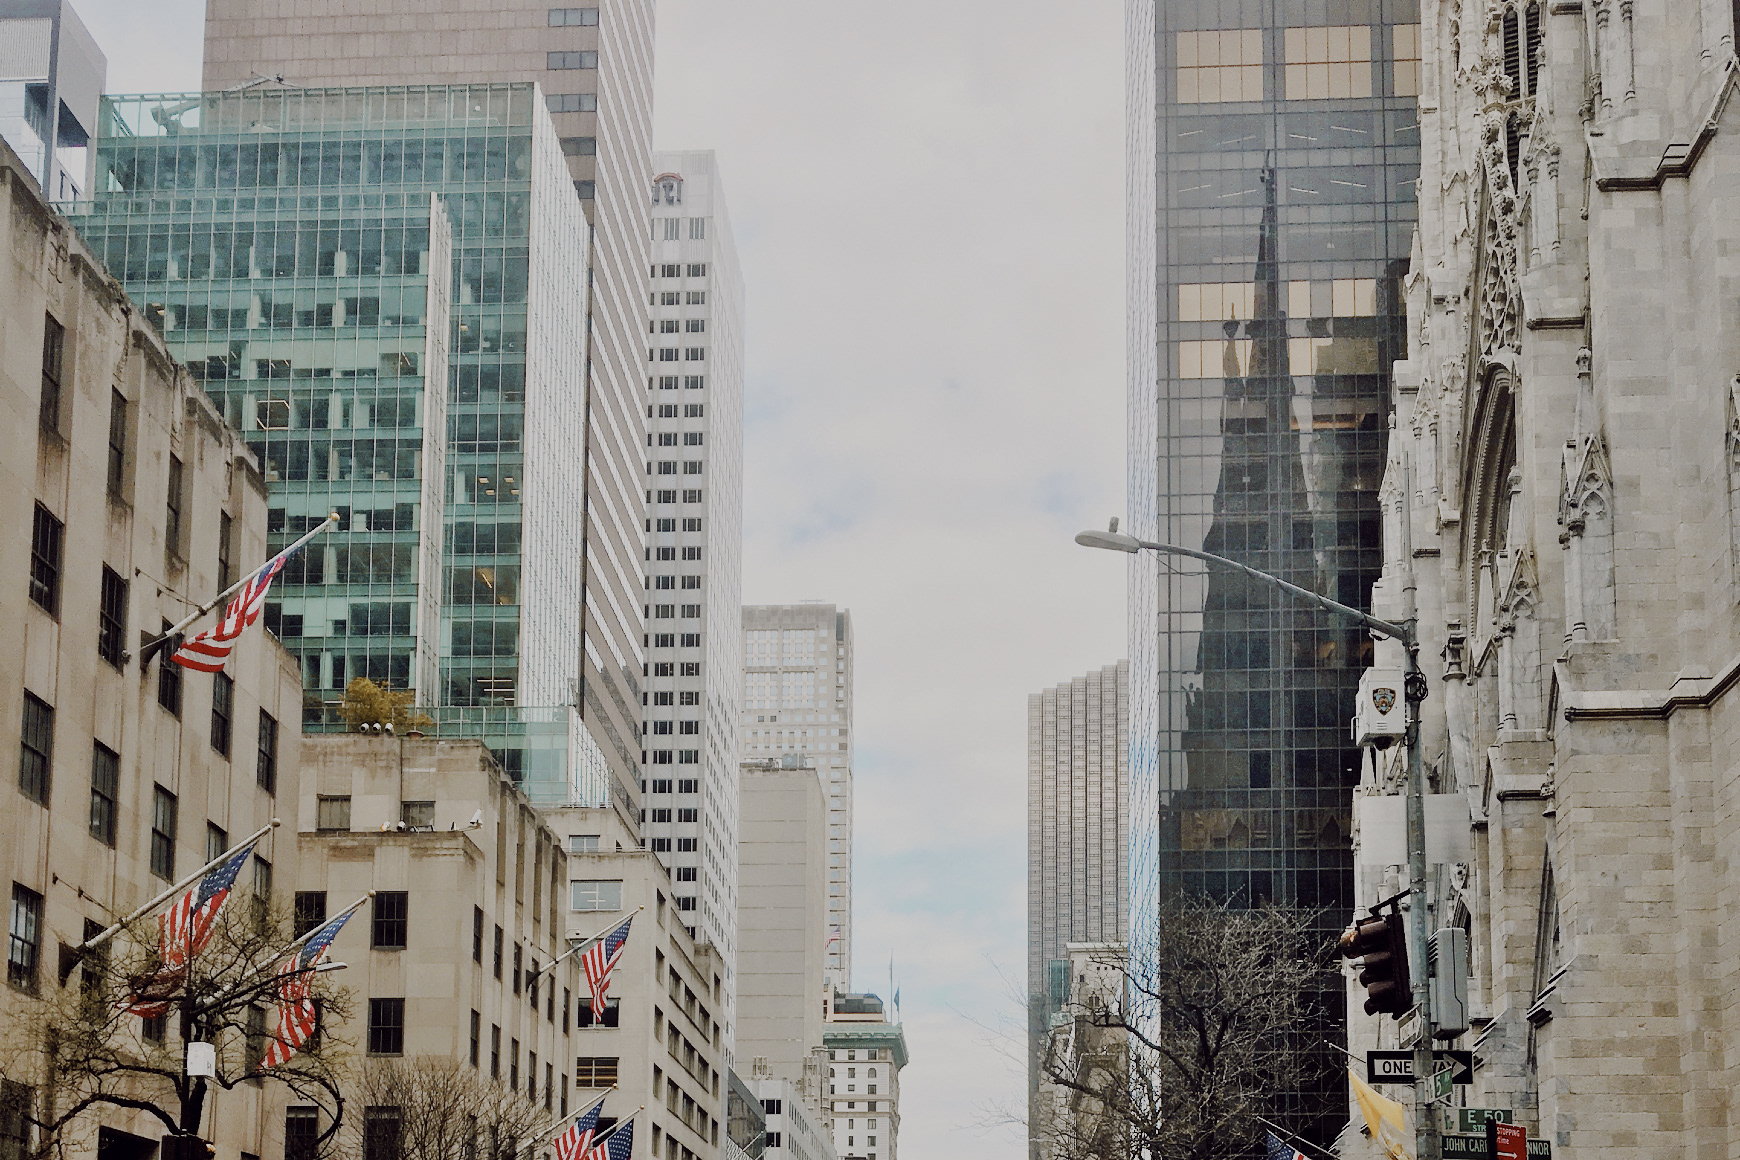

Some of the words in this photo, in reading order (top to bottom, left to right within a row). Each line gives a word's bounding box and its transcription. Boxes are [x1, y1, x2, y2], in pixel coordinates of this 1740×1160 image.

[1383, 1061, 1412, 1074] ONE
[1468, 1110, 1476, 1123] E
[1484, 1110, 1504, 1123] 50
[1472, 1124, 1486, 1132] STR
[1496, 1127, 1520, 1137] STOPPING
[1444, 1138, 1466, 1151] JOHN
